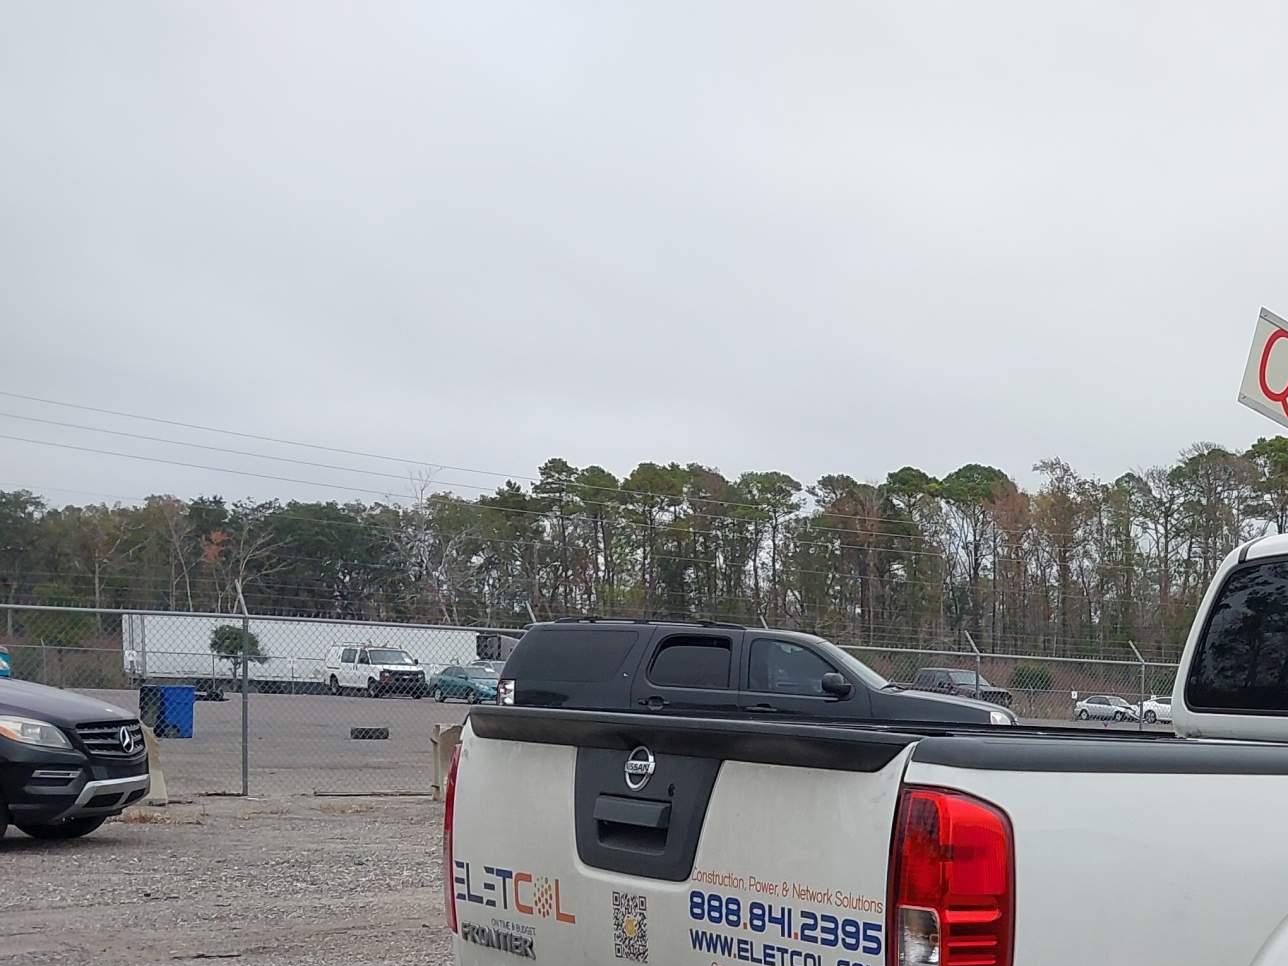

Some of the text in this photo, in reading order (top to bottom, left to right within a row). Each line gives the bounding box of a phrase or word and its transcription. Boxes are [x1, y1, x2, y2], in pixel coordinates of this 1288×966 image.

[692, 867, 748, 891] Construction,
[782, 881, 789, 898] &
[792, 883, 833, 906] Network
[834, 891, 883, 914] Solutions
[461, 921, 537, 961] FRONTIER
[689, 890, 882, 956] 888.841.2395
